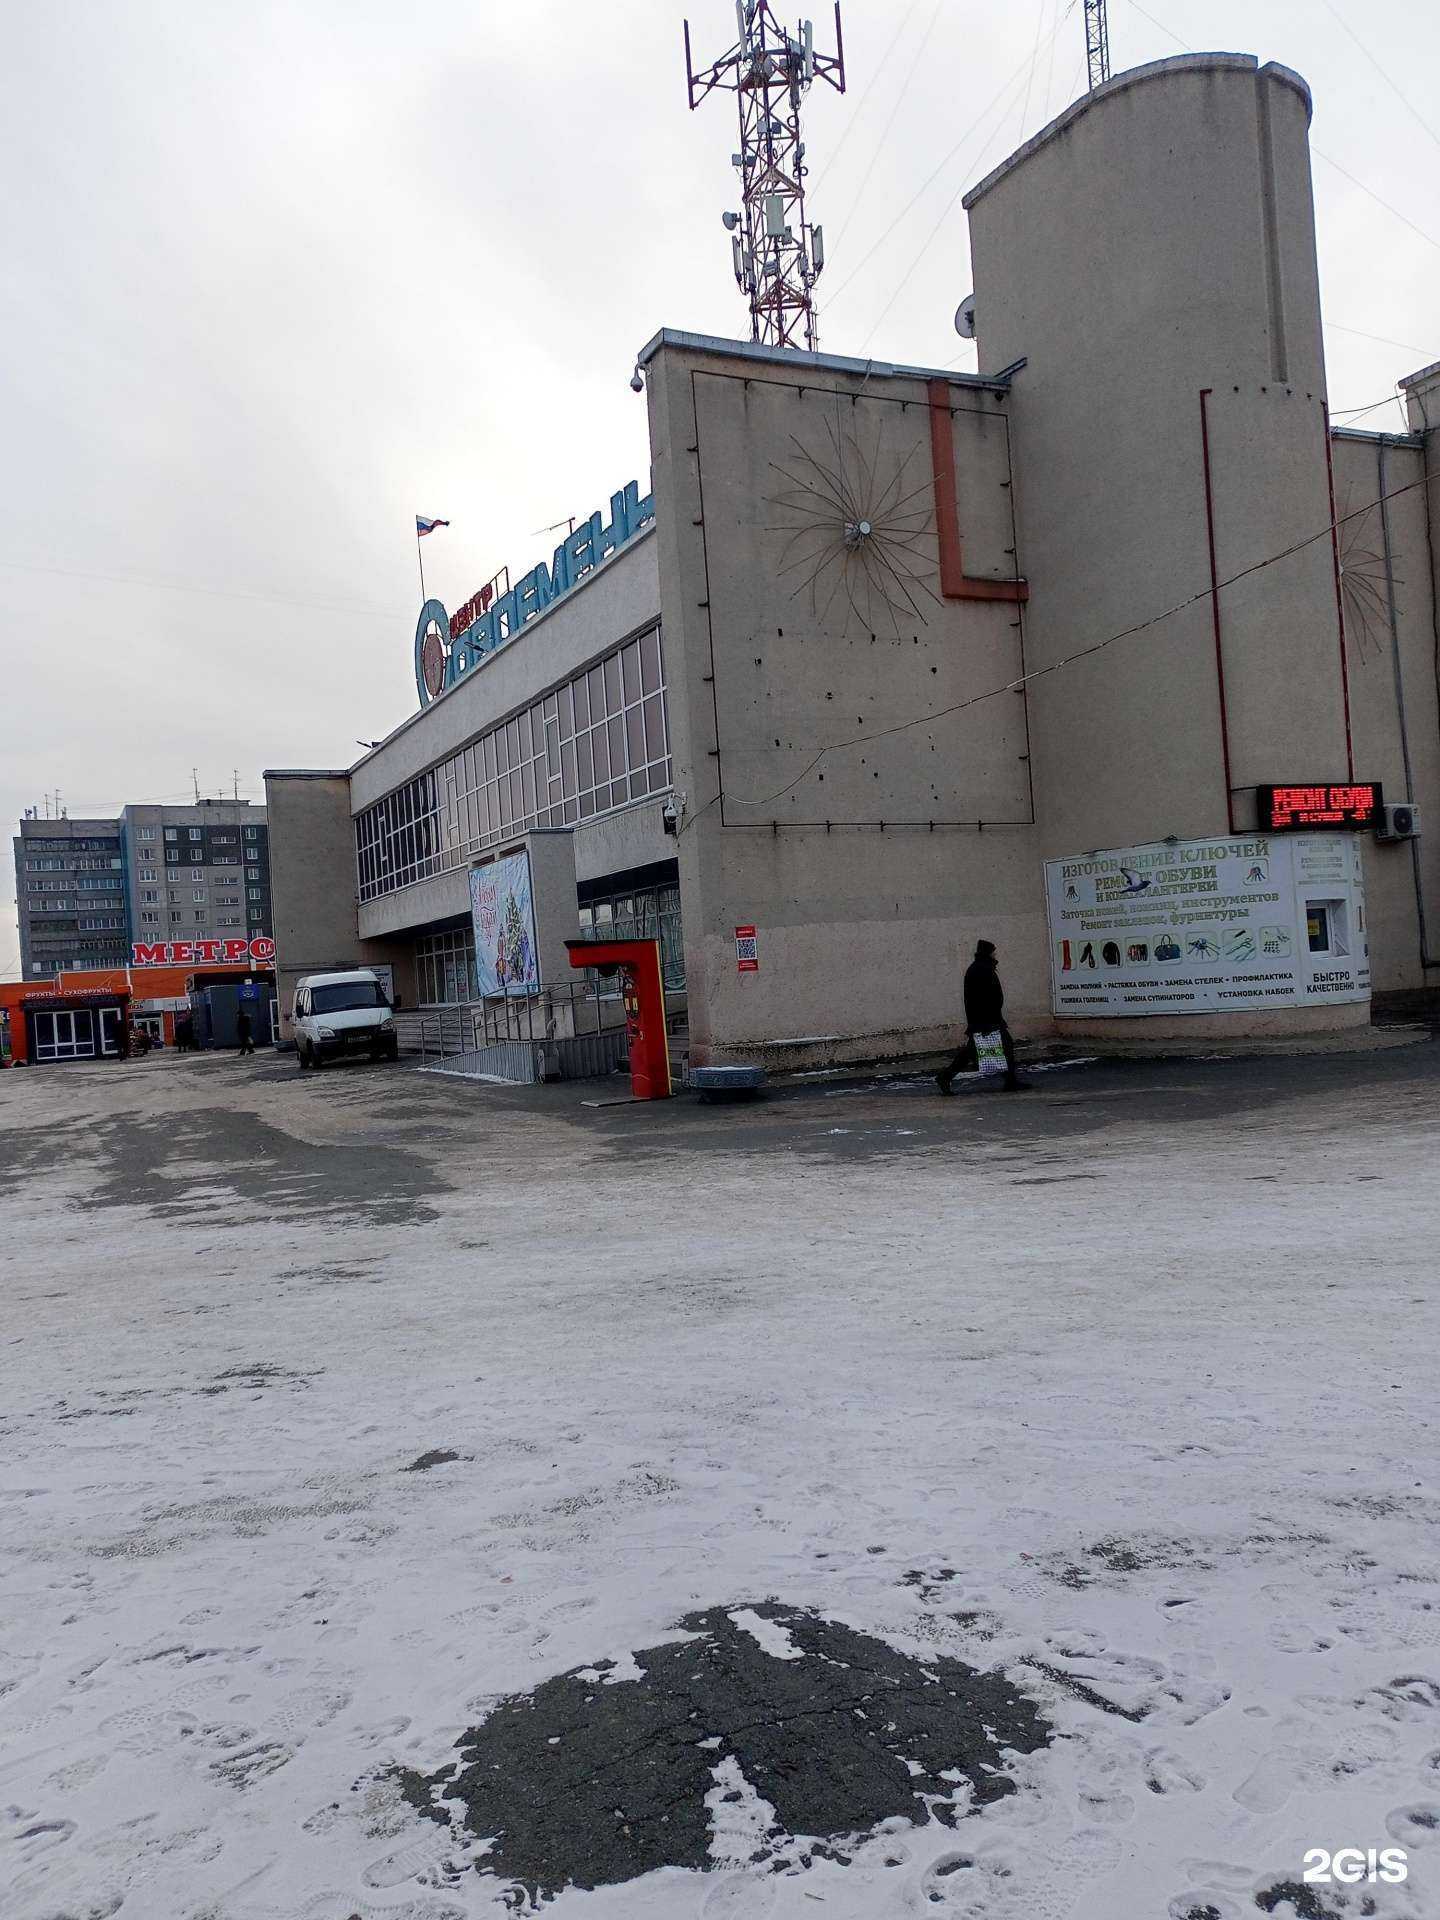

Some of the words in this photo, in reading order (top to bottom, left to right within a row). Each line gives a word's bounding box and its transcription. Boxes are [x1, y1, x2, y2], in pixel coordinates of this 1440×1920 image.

[1062, 852, 1175, 878] ИЗГОТОВЛЕНИЕ
[1180, 840, 1270, 863] КЛЮЧЕЙ
[1156, 865, 1218, 883] ОБУВИ
[132, 937, 275, 966] МЕТРО
[1165, 979, 1193, 987] ЗАМЕНА
[1195, 976, 1224, 985] СТЕЛЕК
[1232, 972, 1294, 983] ПРОФИЛАКТИКА
[1313, 971, 1350, 983] БЫСТРО
[64, 987, 112, 996] СУХОФРУКТЫ
[1148, 993, 1195, 1002] СУПИНАТОРОВ
[1217, 989, 1264, 999] УСТАНОВКА
[1265, 987, 1295, 996] НАБОЕК
